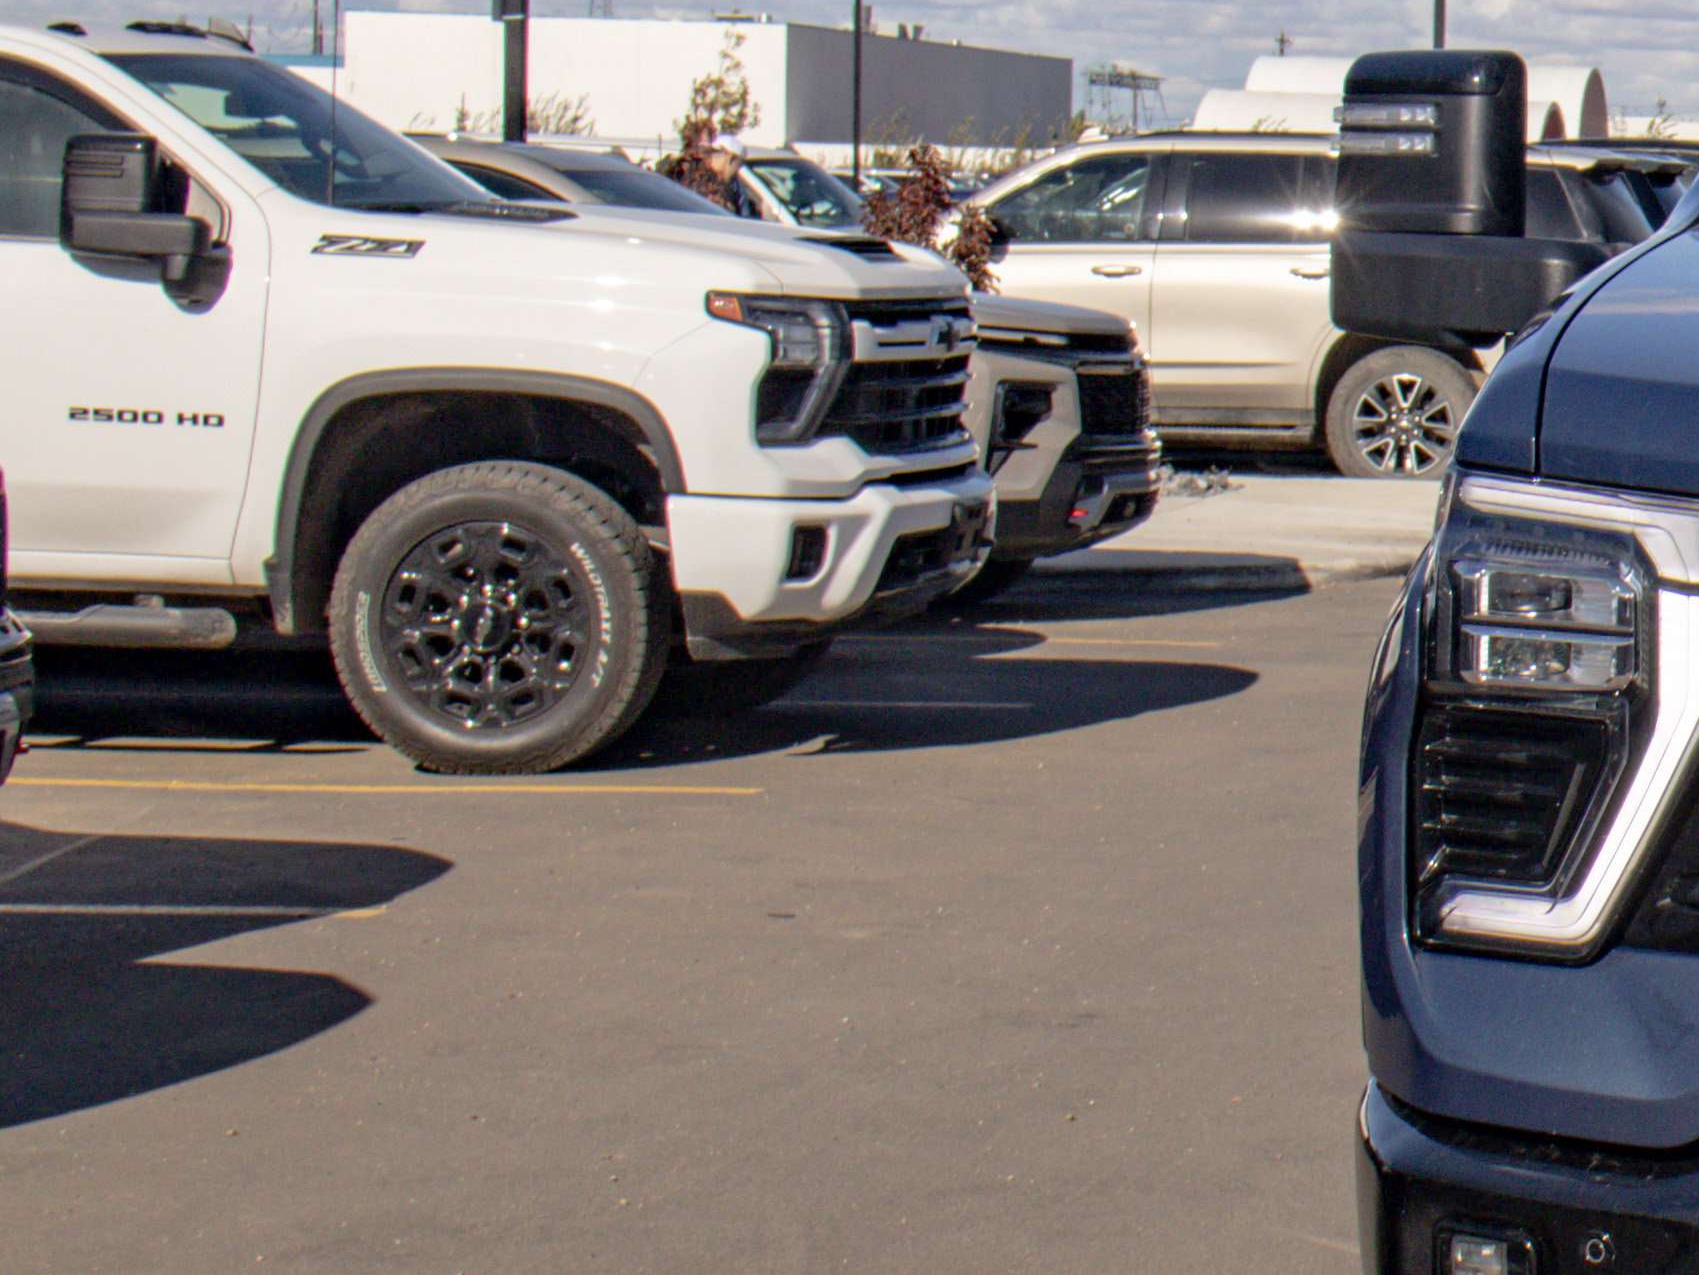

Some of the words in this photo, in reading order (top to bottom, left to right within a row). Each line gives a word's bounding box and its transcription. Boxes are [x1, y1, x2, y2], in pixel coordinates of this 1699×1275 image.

[310, 233, 426, 258] Z71
[68, 407, 165, 425] 2500
[176, 412, 225, 428] HD
